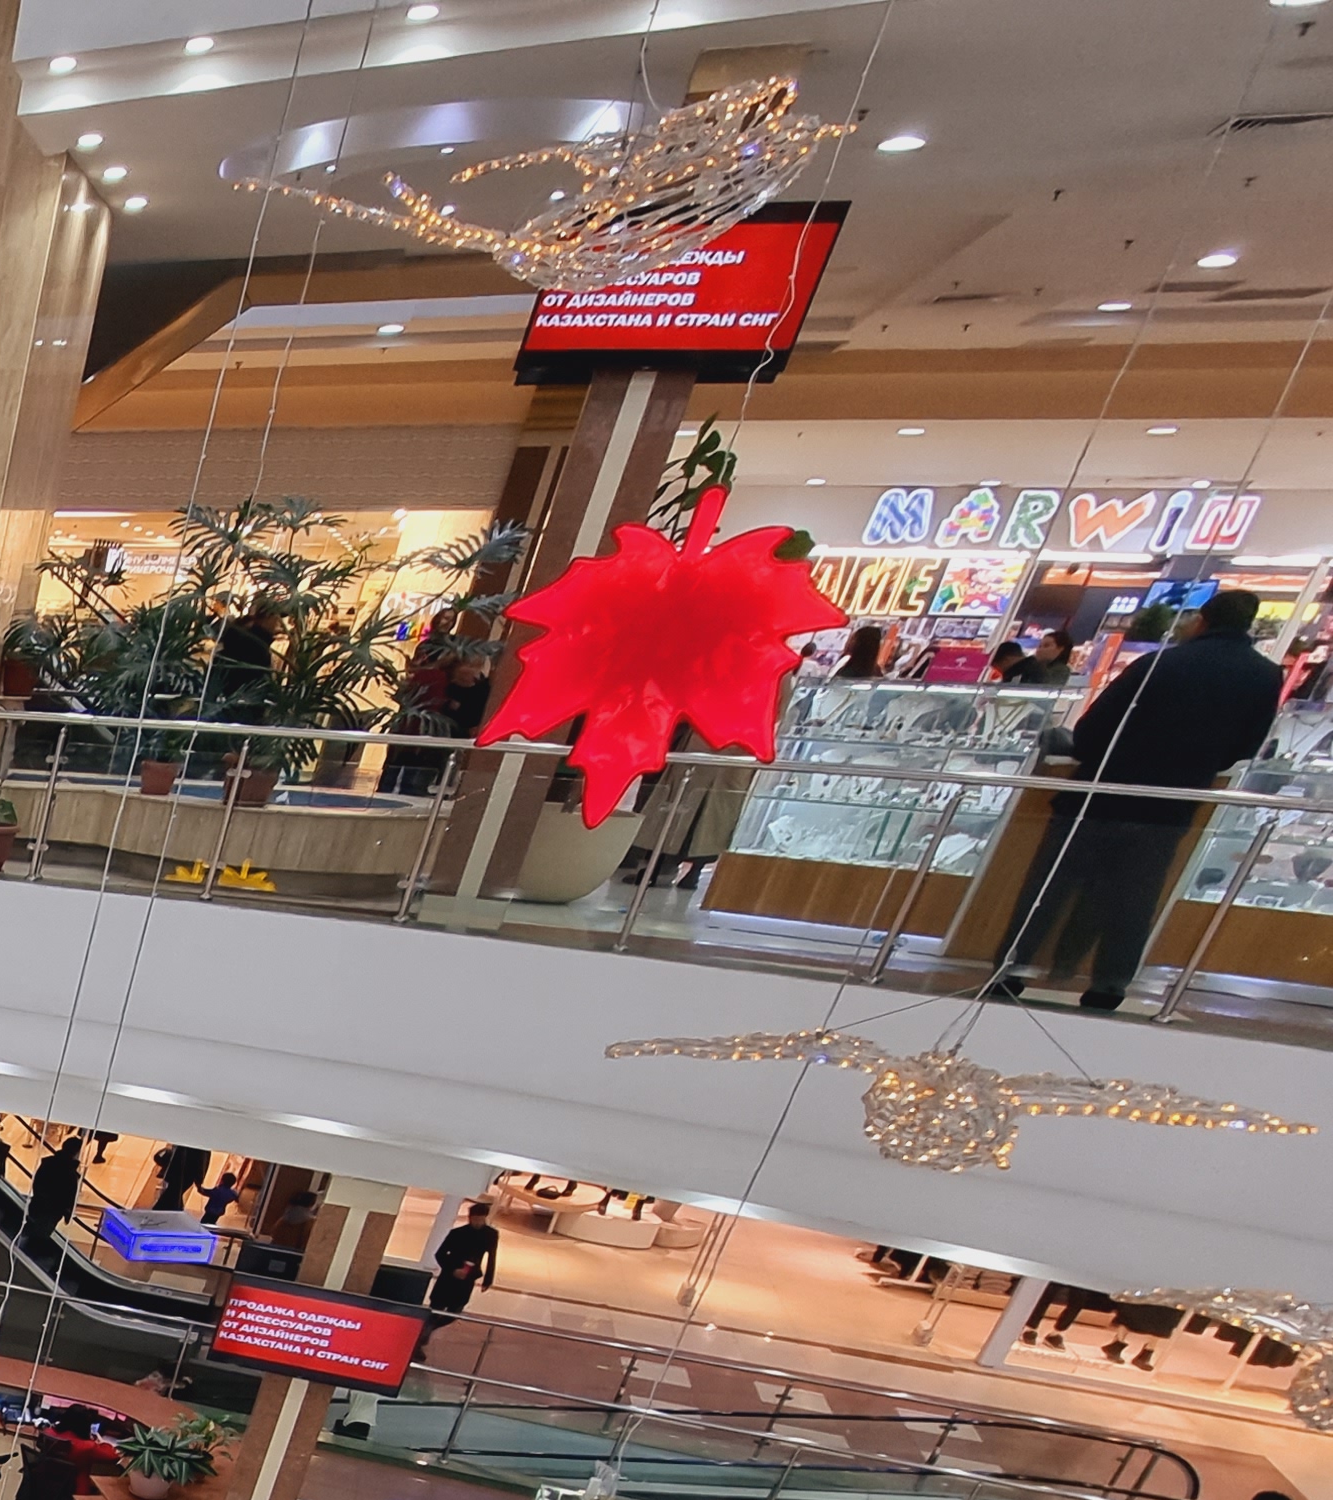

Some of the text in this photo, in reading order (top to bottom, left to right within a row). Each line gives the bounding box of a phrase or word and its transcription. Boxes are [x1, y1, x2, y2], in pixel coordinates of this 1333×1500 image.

[542, 290, 696, 309] ОТ ДИЗАЙНЕРОВ
[535, 313, 779, 328] КАЗАХСТАНА И СТРАН СНГ
[225, 1309, 332, 1336] И АКСЕССУАРОВ
[229, 1298, 362, 1331] ПРОДАЖА ОДЕЖДЫ
[222, 1320, 330, 1347] ОТ ДИЗАЙНЕРОВ
[219, 1330, 390, 1371] КАЗАХСТАНА И СТРАН СНГ
